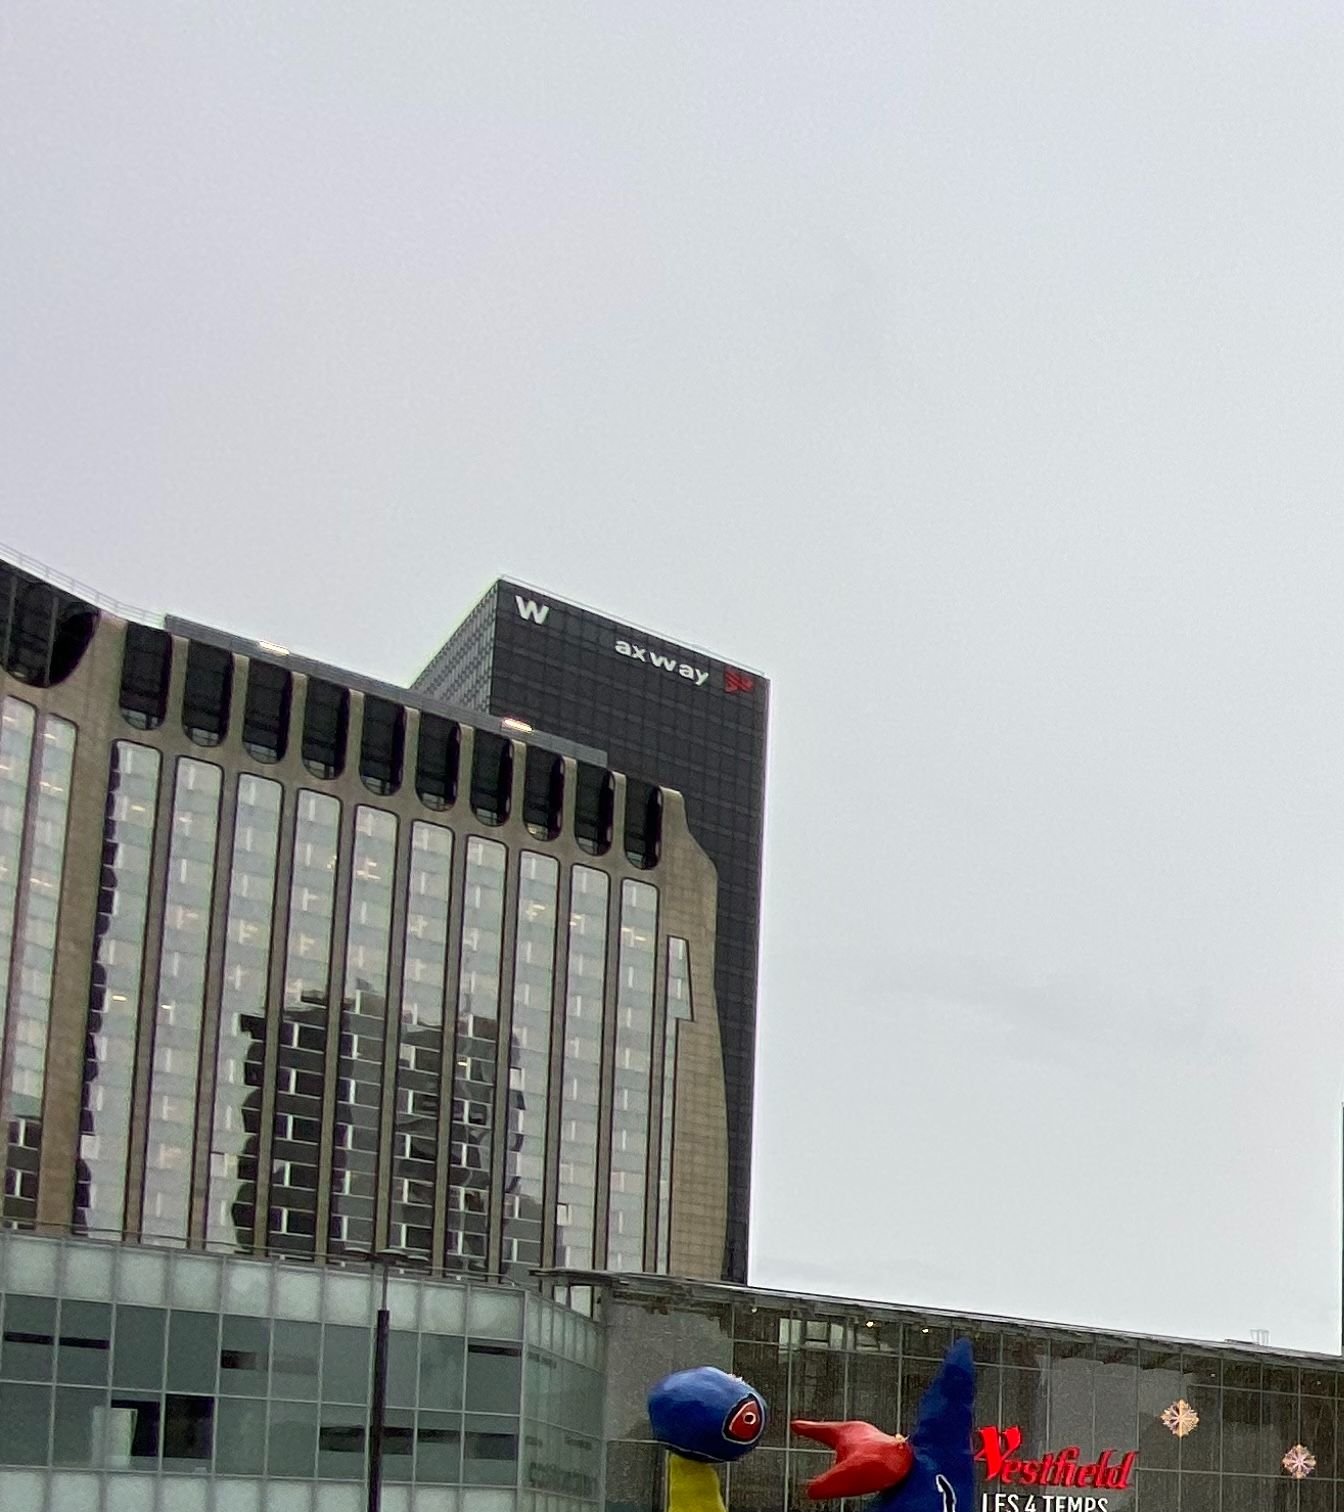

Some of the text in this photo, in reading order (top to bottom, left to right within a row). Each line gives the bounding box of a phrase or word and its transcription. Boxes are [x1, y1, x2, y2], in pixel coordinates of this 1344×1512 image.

[515, 595, 550, 624] W
[615, 639, 710, 686] axway
[974, 1424, 1139, 1489] Westfield
